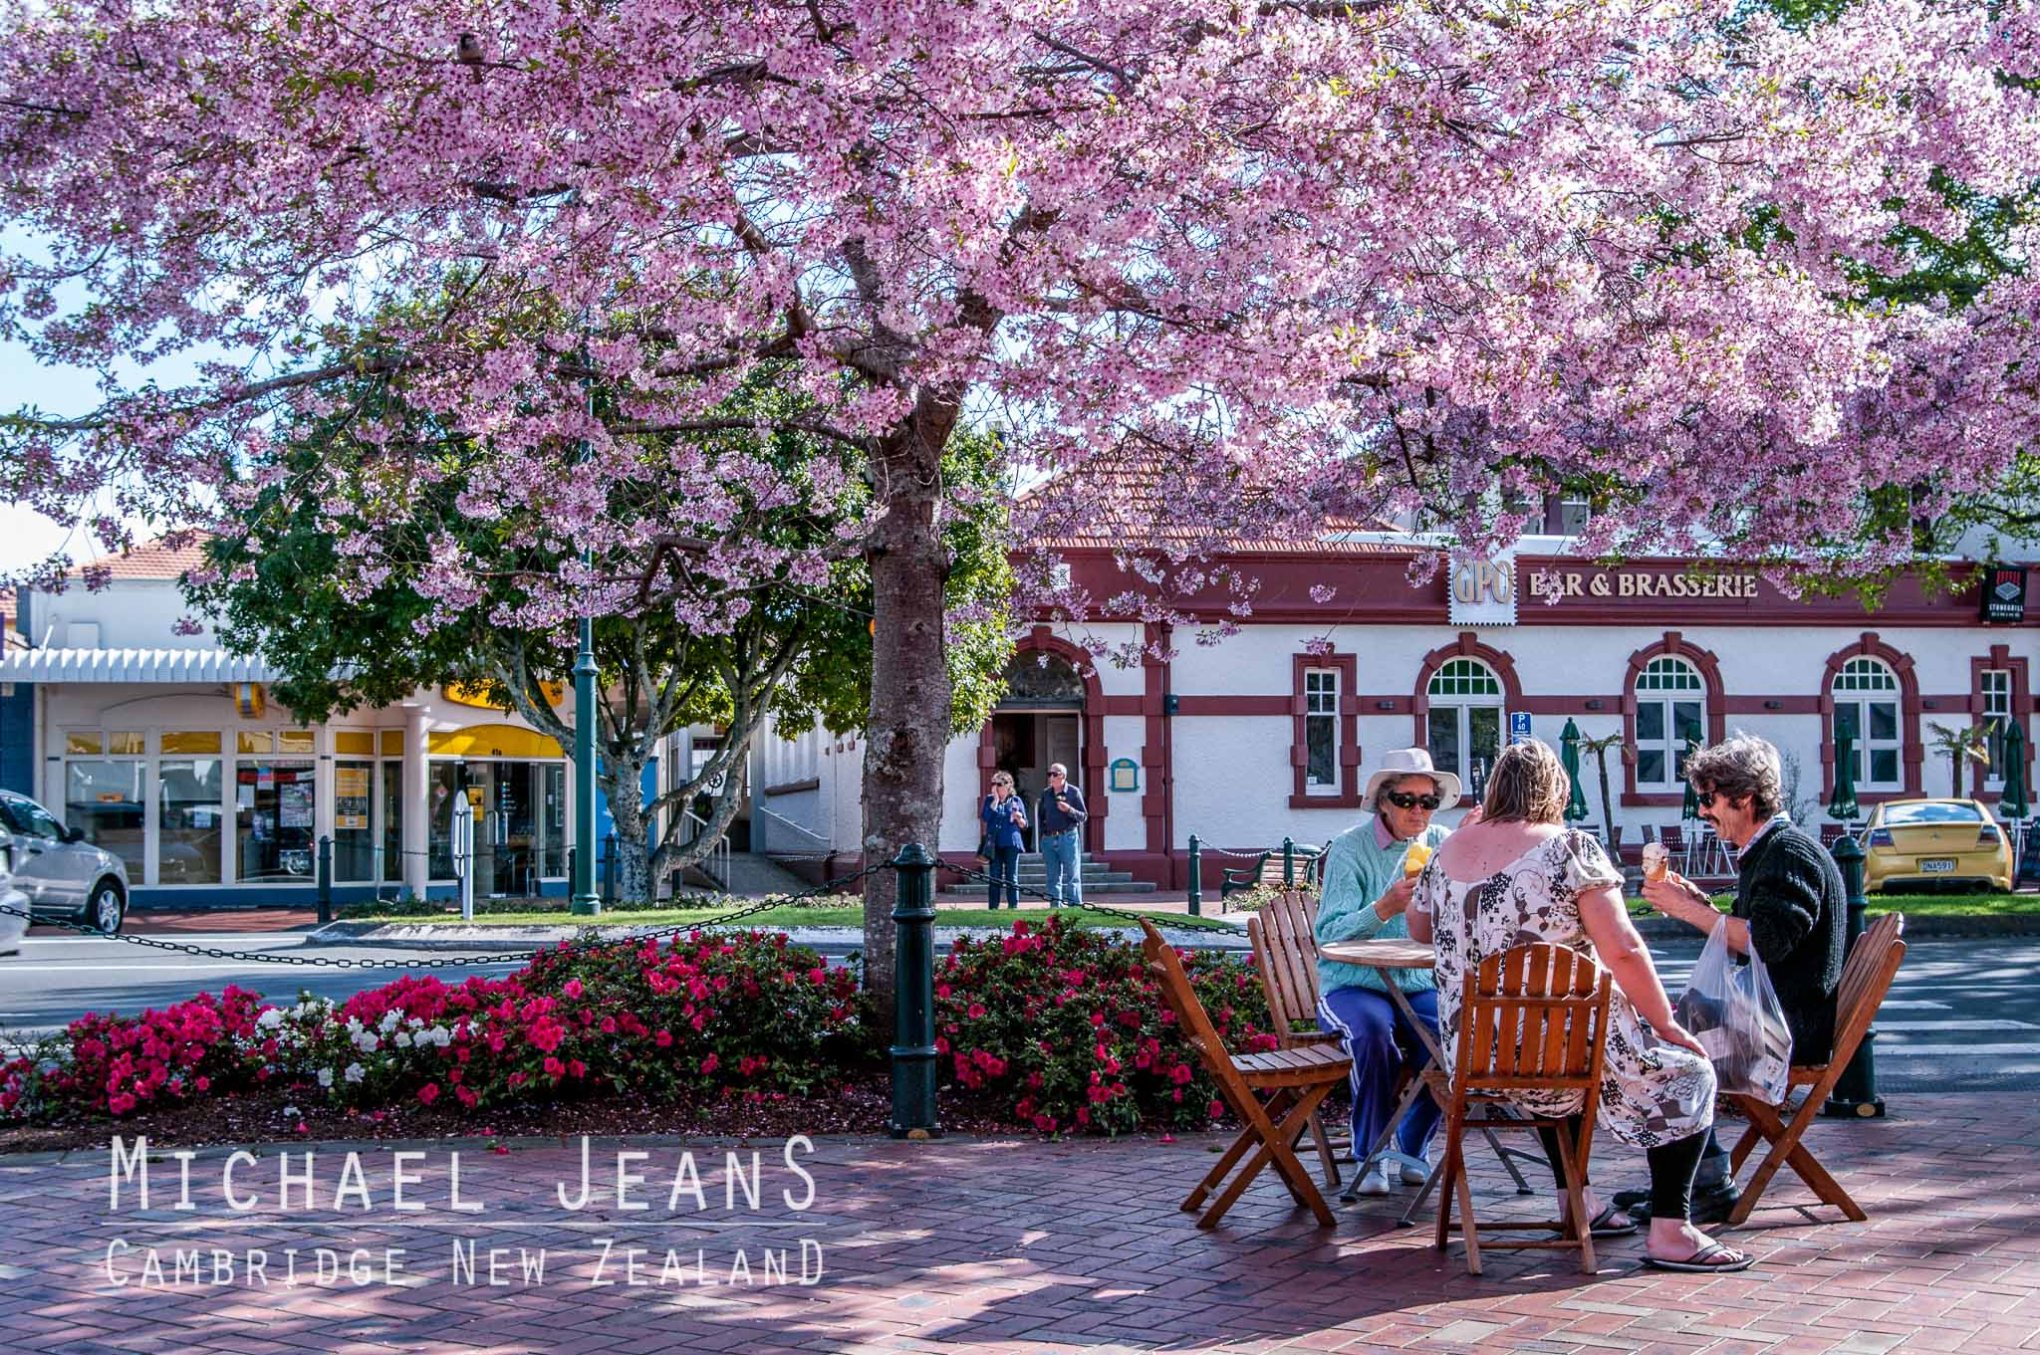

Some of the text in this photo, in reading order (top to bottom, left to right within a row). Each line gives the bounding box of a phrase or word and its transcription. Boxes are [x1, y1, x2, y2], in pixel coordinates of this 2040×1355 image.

[1452, 557, 1513, 604] GPO
[1589, 573, 1612, 597] &
[1618, 573, 1759, 597] BRASSERIE
[1518, 714, 1526, 723] P
